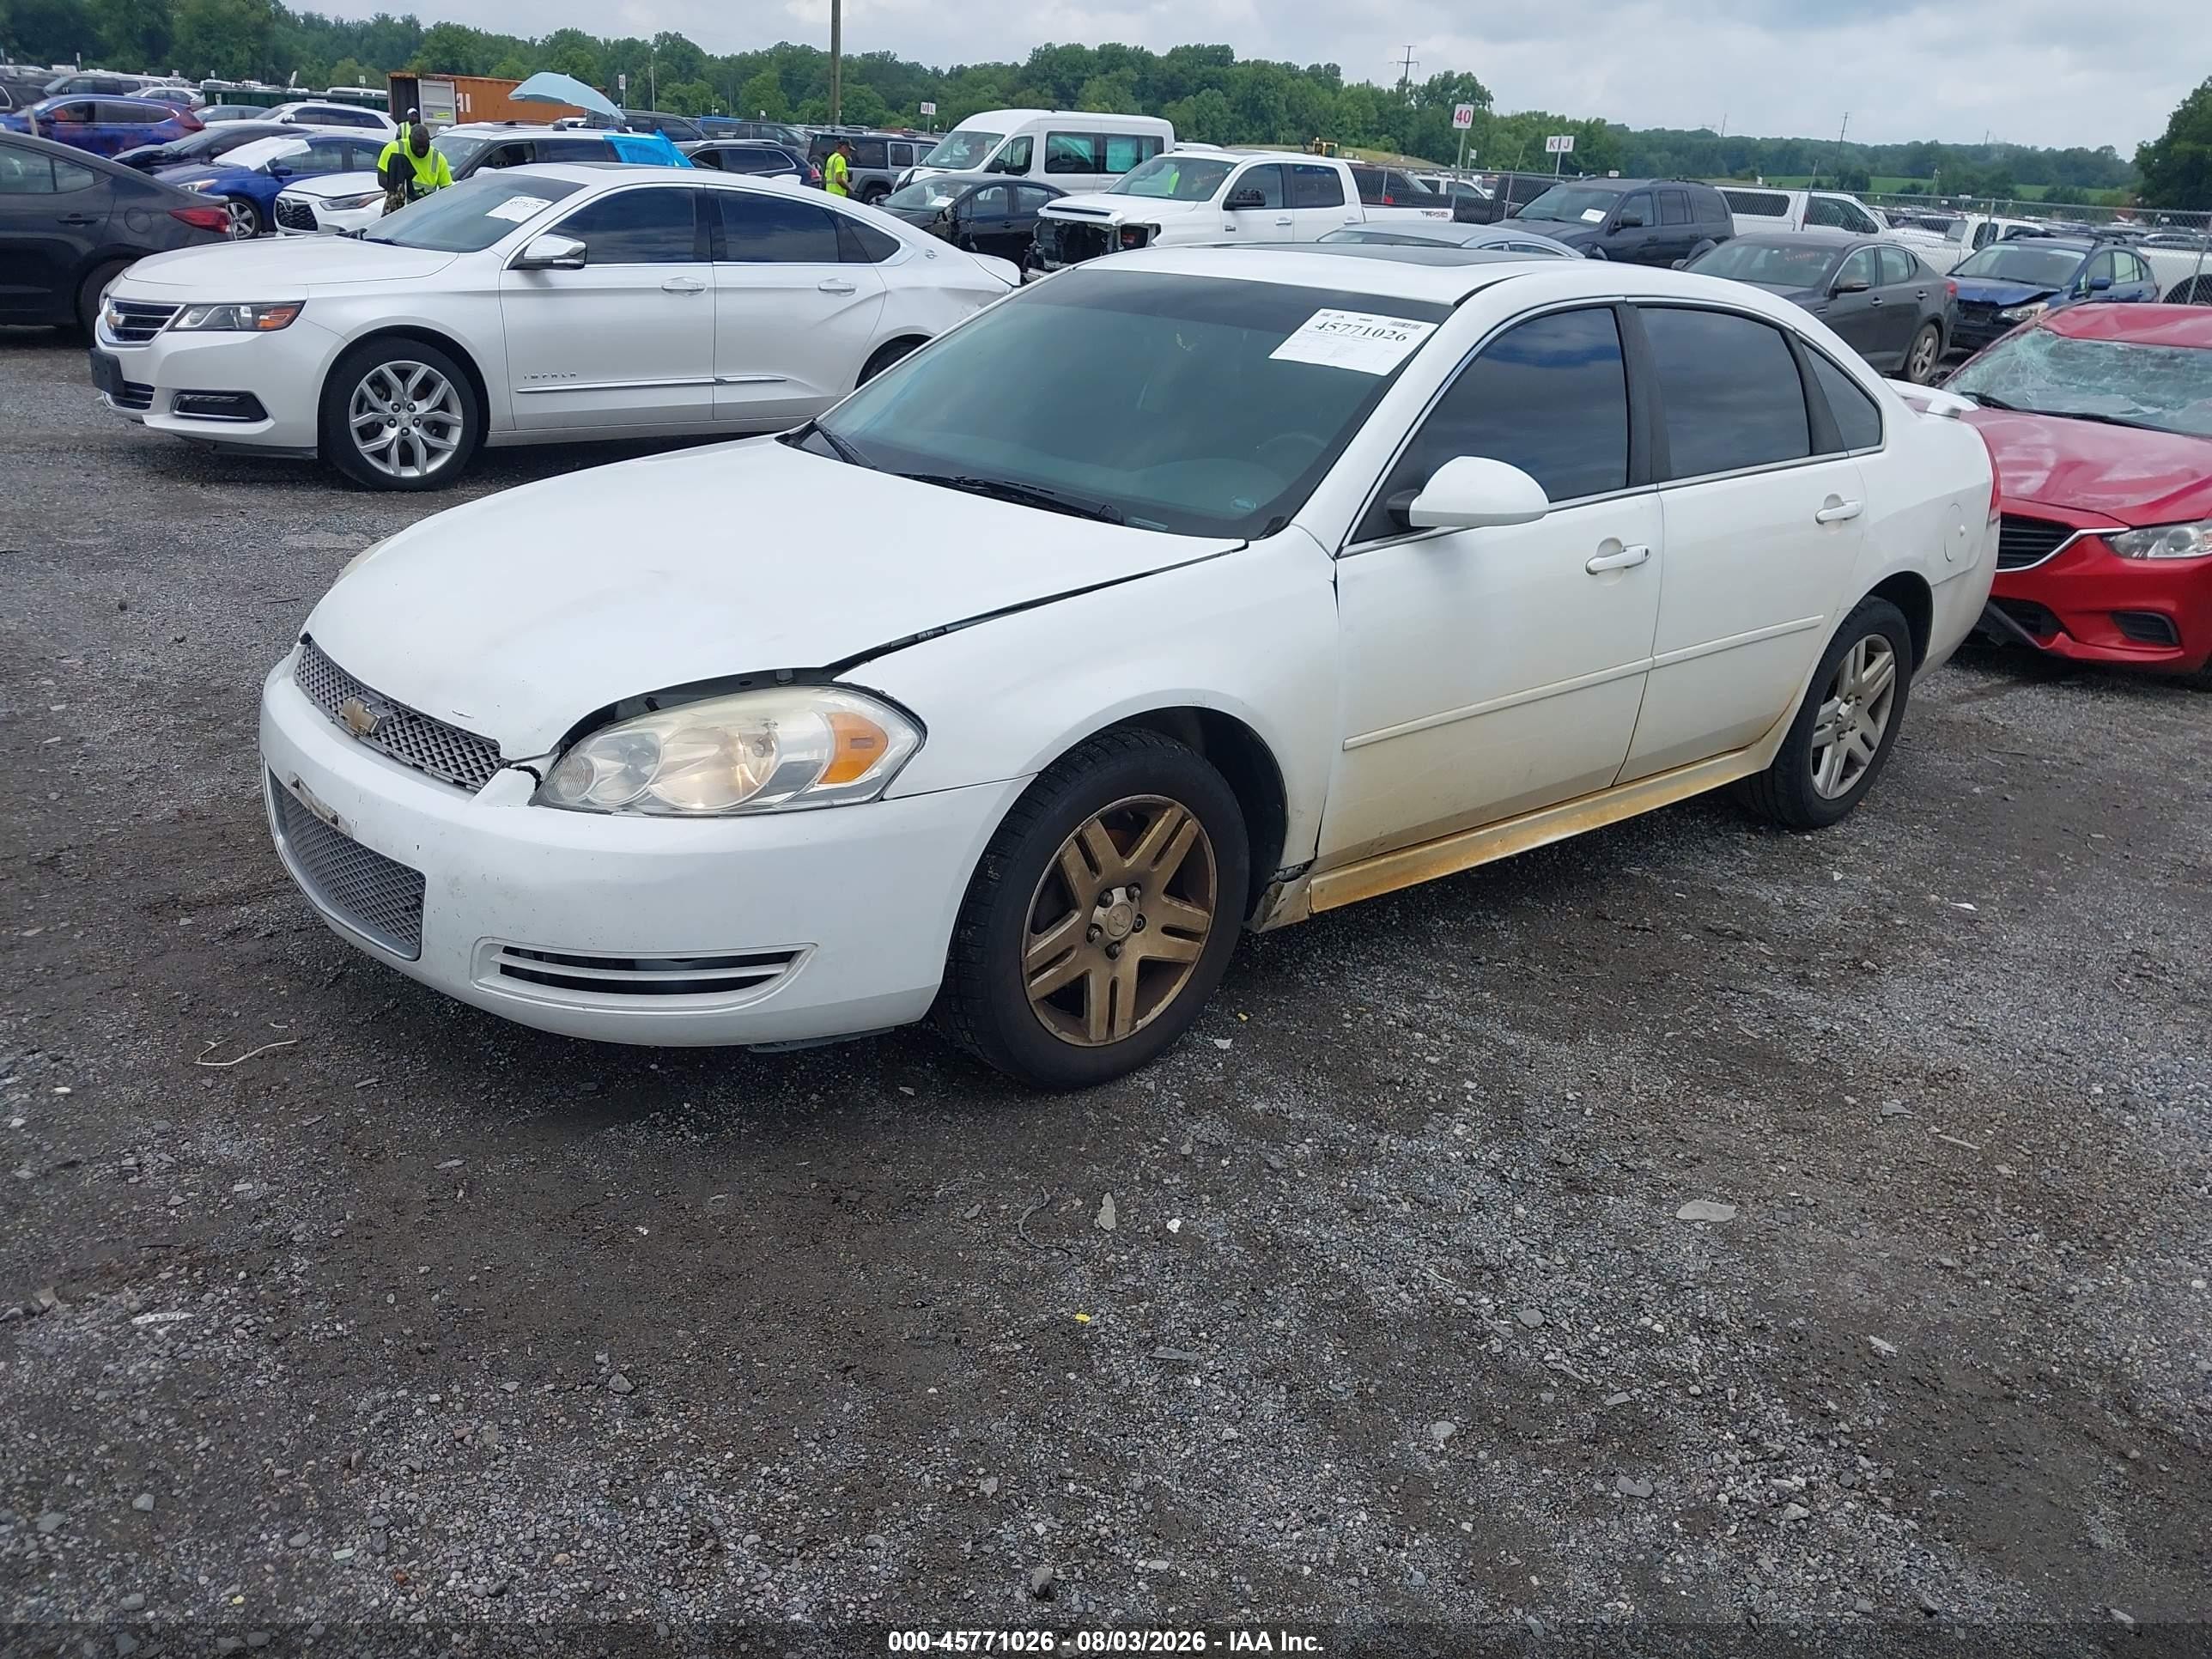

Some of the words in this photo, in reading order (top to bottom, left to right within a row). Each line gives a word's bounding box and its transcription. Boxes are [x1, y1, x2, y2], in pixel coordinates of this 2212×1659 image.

[1455, 109, 1472, 124] 40
[1549, 138, 1555, 149] K
[1563, 138, 1570, 149] J
[1315, 321, 1408, 343] 45771026
